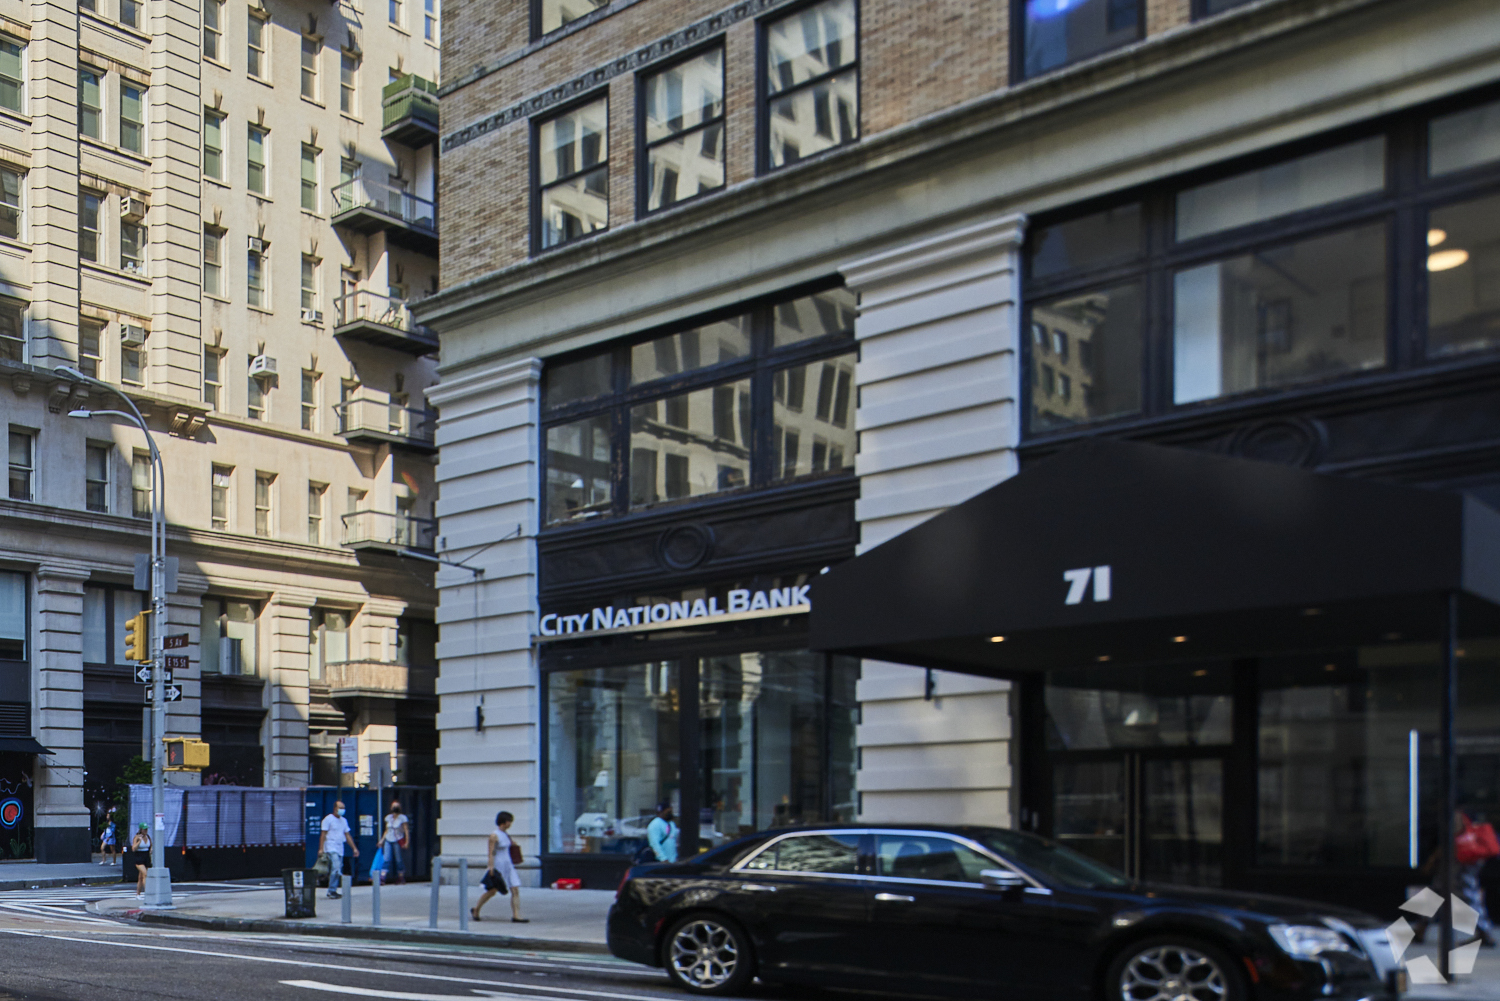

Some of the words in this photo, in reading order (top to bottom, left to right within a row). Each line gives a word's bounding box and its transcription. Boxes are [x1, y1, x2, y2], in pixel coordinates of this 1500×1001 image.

[1063, 565, 1112, 605] 71
[540, 613, 589, 637] CITY
[592, 597, 725, 631] NATIONAL
[727, 584, 811, 614] BANK
[167, 658, 171, 667] E
[172, 658, 179, 667] 15
